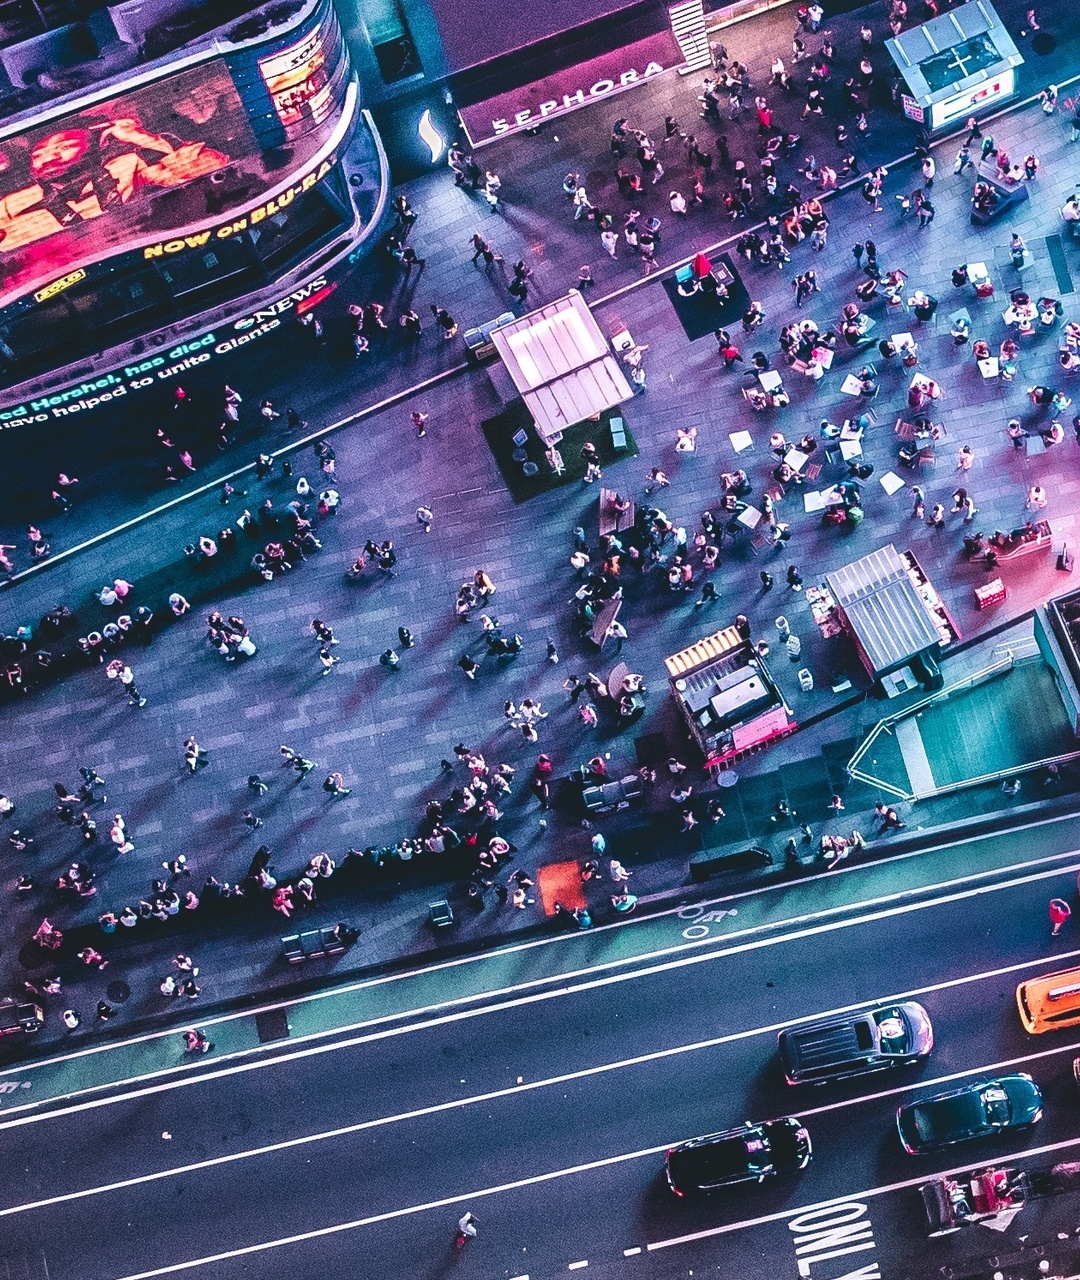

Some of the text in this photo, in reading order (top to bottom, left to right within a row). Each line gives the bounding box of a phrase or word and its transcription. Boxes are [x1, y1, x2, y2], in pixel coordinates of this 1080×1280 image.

[491, 61, 663, 135] SEPHORA
[143, 231, 211, 259] NOW
[217, 218, 248, 238] ON
[253, 275, 327, 323] NEWS
[52, 384, 127, 418] helped
[130, 376, 153, 389] to
[157, 353, 211, 379] unite
[215, 319, 281, 354] Giants
[124, 357, 165, 377] has
[169, 333, 216, 359] died
